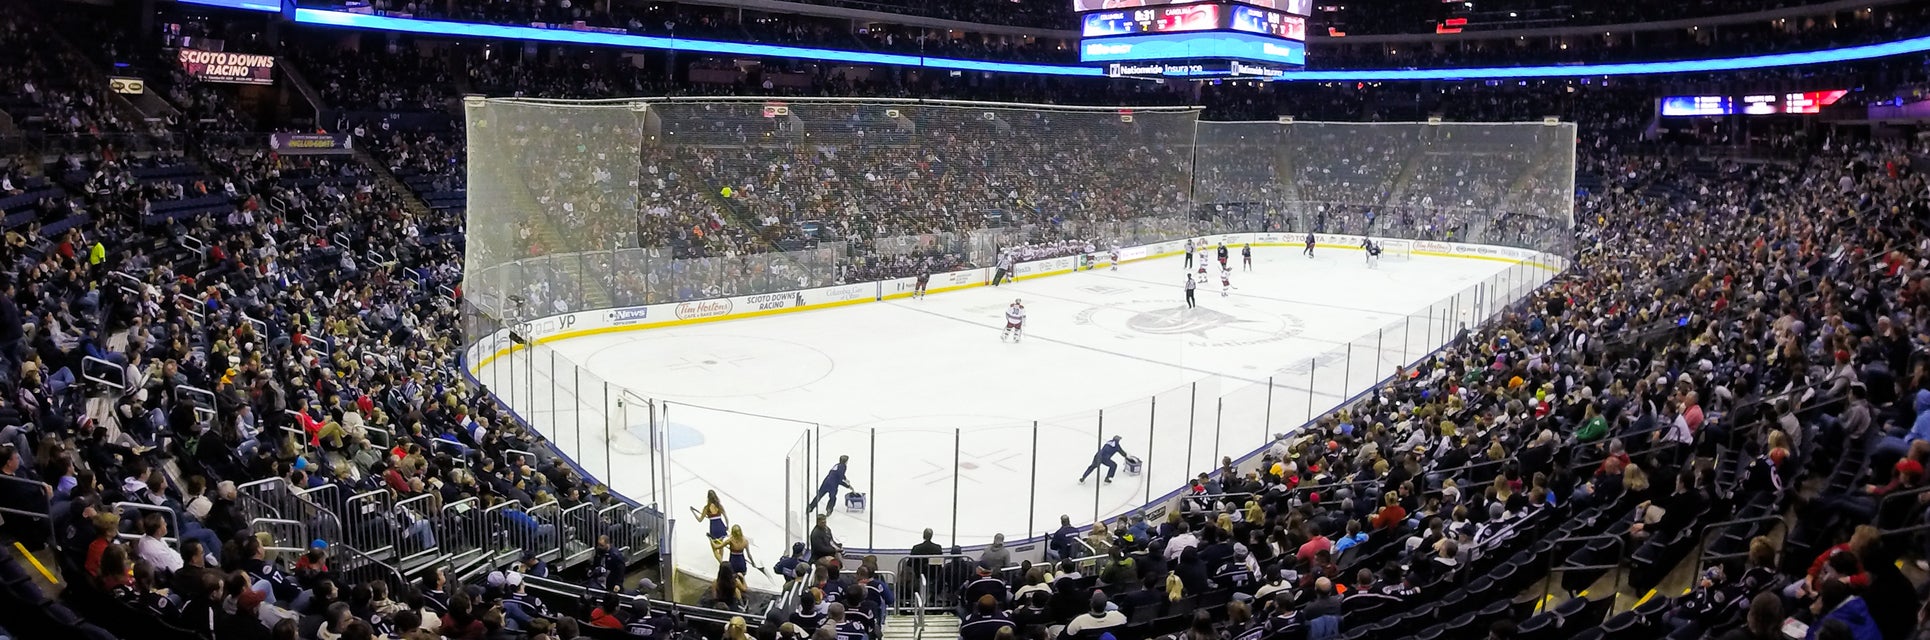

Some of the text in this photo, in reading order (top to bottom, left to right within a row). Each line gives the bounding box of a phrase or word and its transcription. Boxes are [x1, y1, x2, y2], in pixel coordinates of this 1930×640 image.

[180, 51, 275, 68] SCIOTO DOWNS
[206, 64, 249, 77] RACINO
[1121, 64, 1163, 75] Nationwide
[747, 292, 795, 304] SCIOTO DOWNS
[680, 300, 728, 314] Tim Hortons
[759, 301, 784, 310] RACINO
[559, 314, 576, 330] yp
[272, 570, 284, 584] 17
